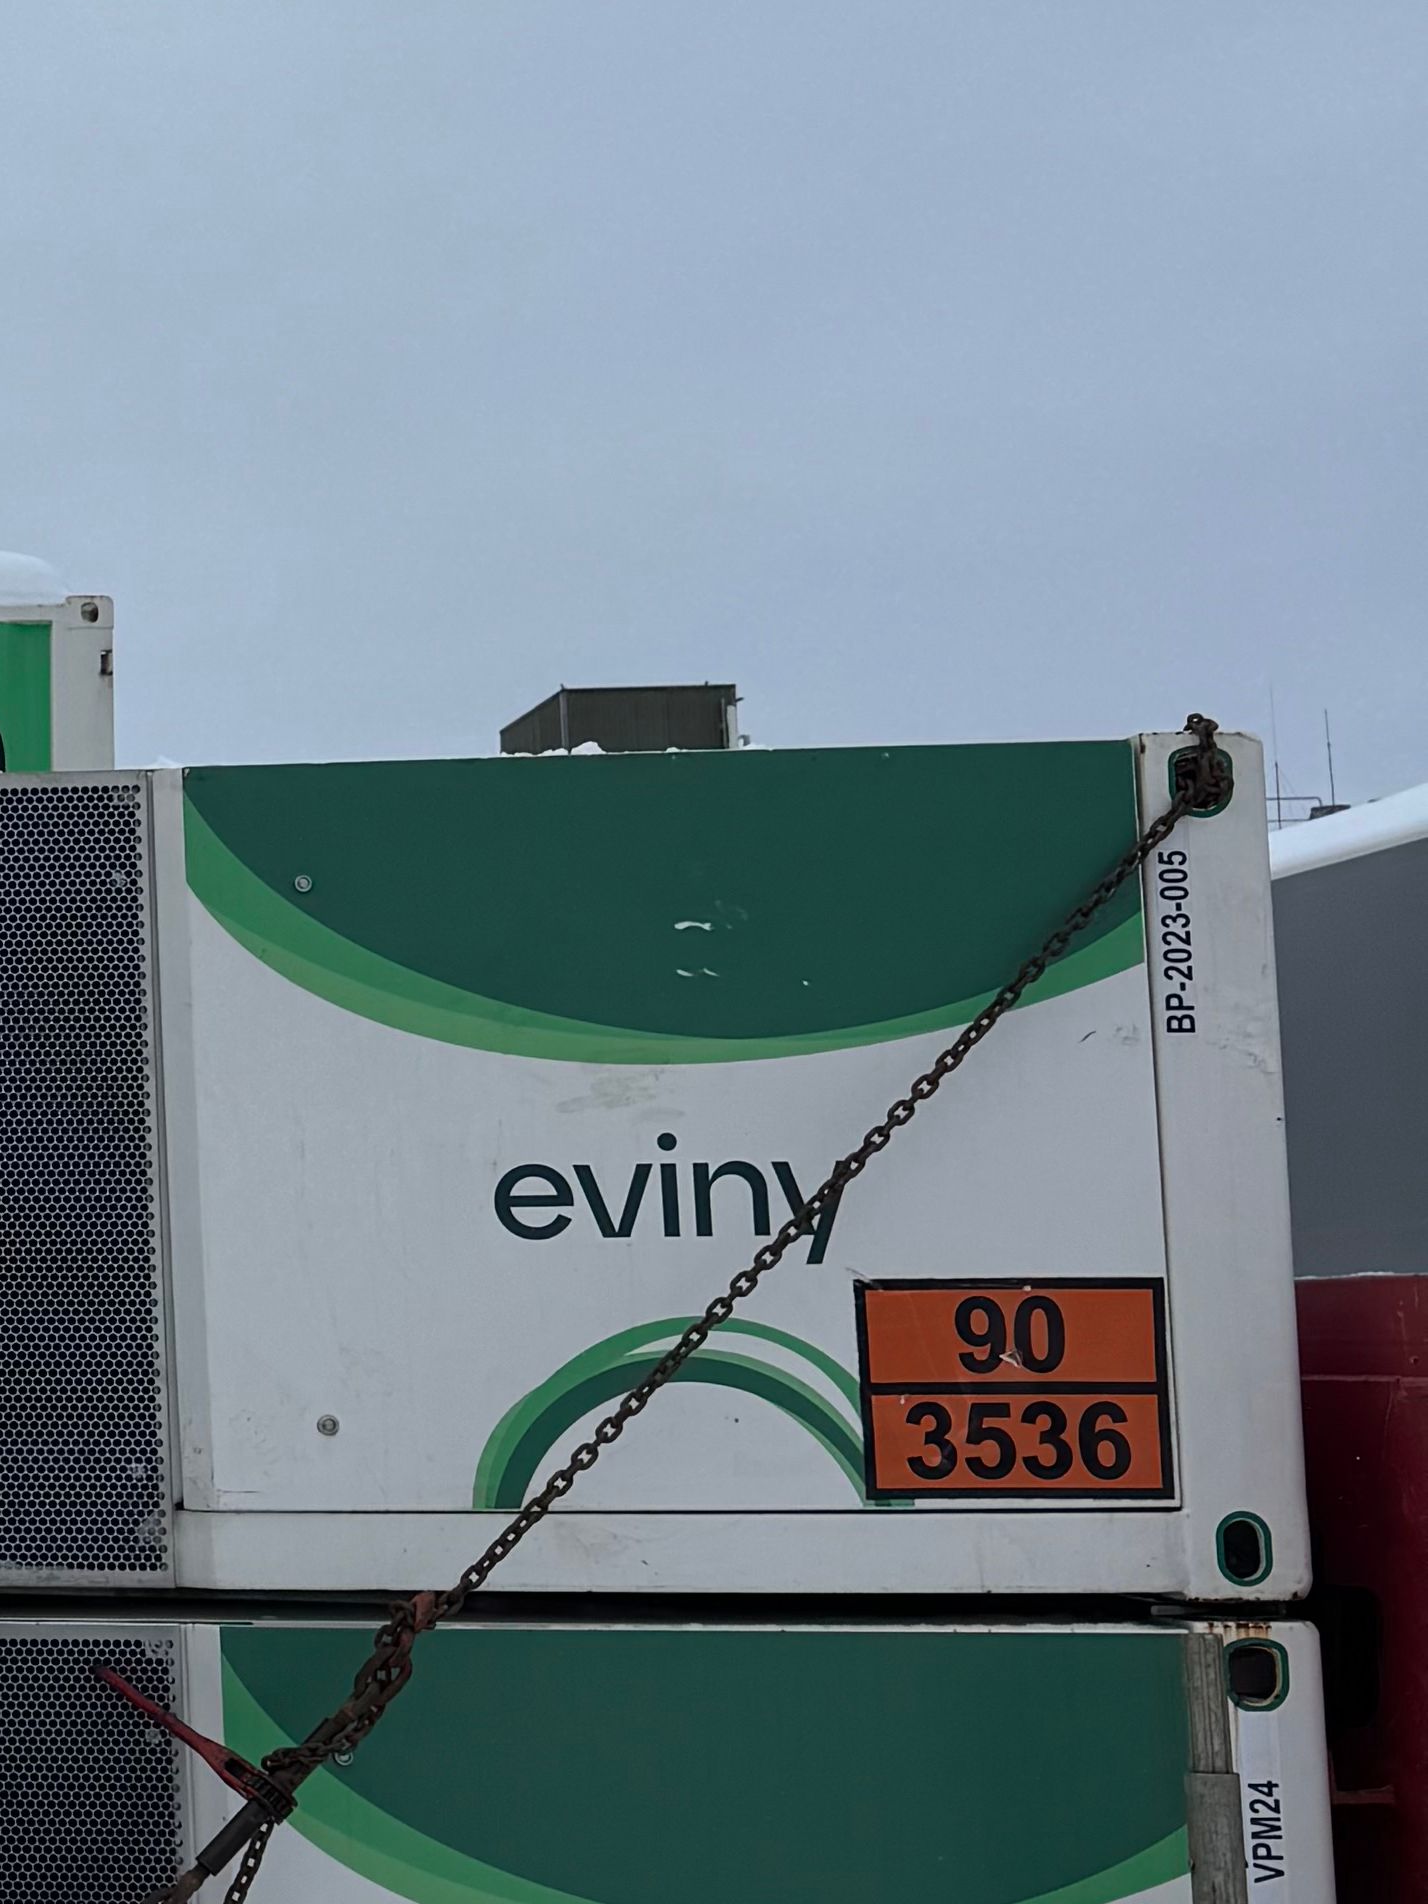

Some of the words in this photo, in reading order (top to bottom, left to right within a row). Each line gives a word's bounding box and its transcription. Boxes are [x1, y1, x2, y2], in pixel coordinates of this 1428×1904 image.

[1157, 850, 1196, 1034] BP-2023-005
[493, 1132, 846, 1265] eviny
[954, 1294, 1066, 1375] 90
[905, 1400, 1132, 1481] 3536
[1247, 1780, 1286, 1884] VPM24
